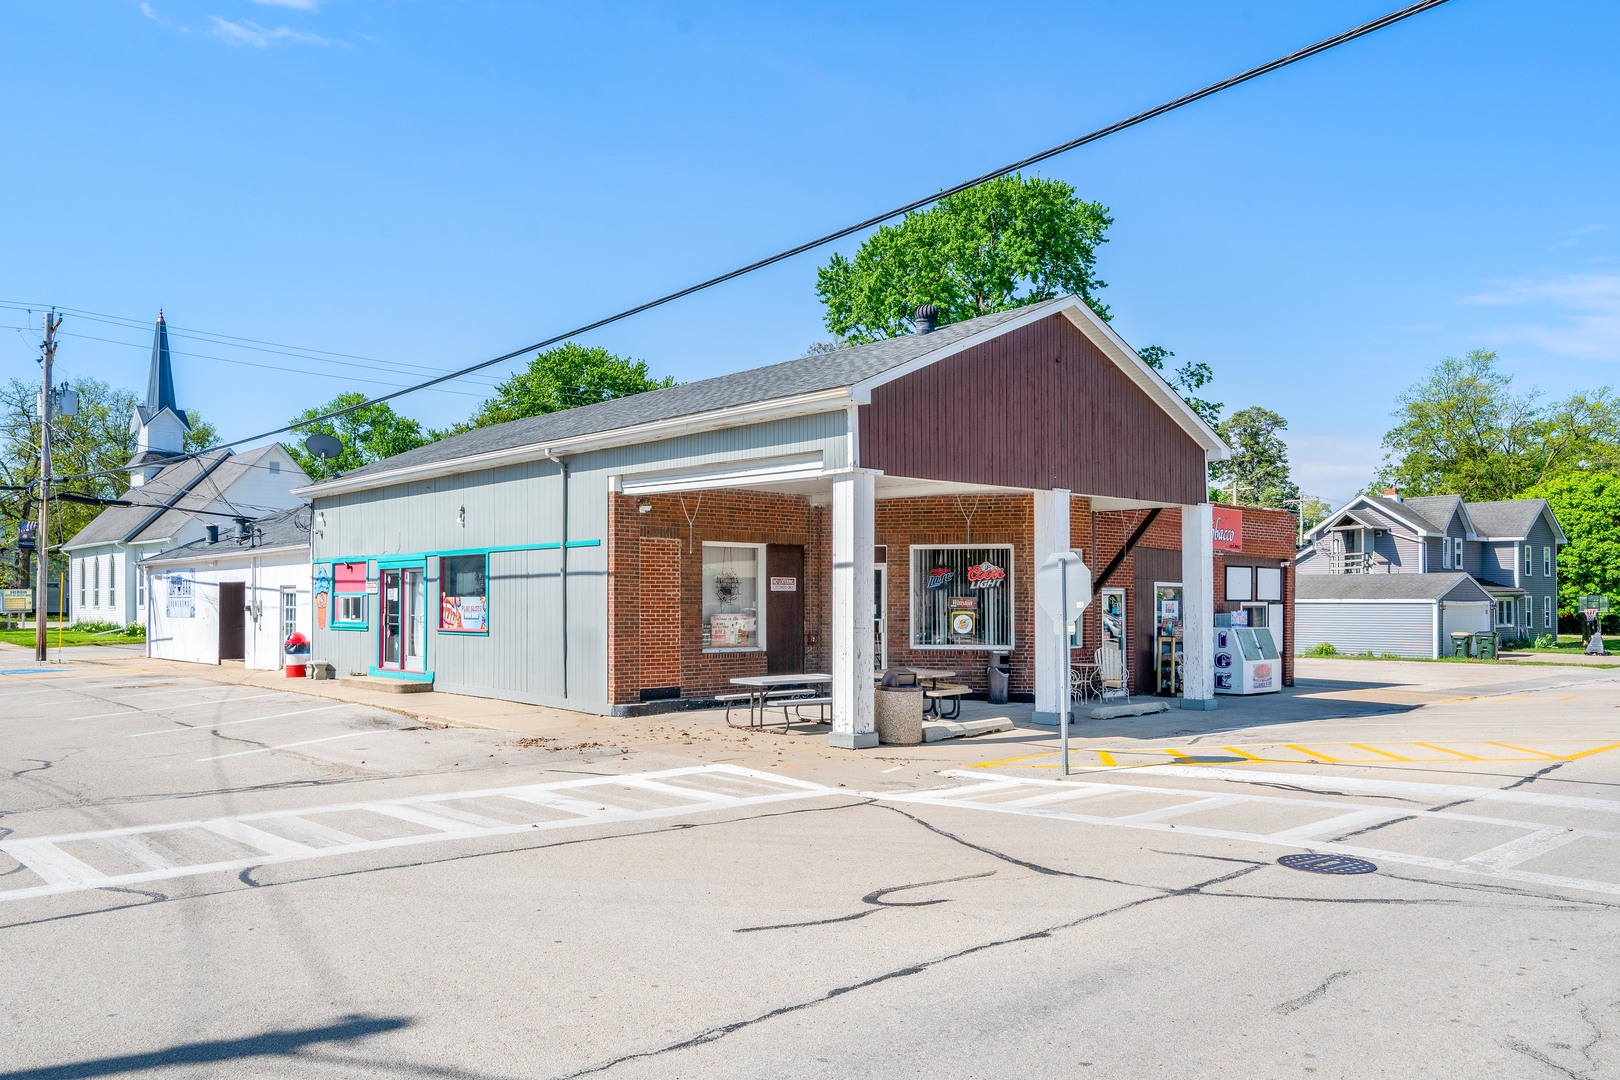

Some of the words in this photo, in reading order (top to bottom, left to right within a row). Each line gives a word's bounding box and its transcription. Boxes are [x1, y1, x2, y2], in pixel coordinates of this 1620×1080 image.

[1211, 516, 1235, 542] obacco
[927, 572, 954, 588] Lite
[967, 565, 1005, 581] Coors
[970, 579, 1004, 590] LIGHT
[1214, 631, 1232, 689] ICE
